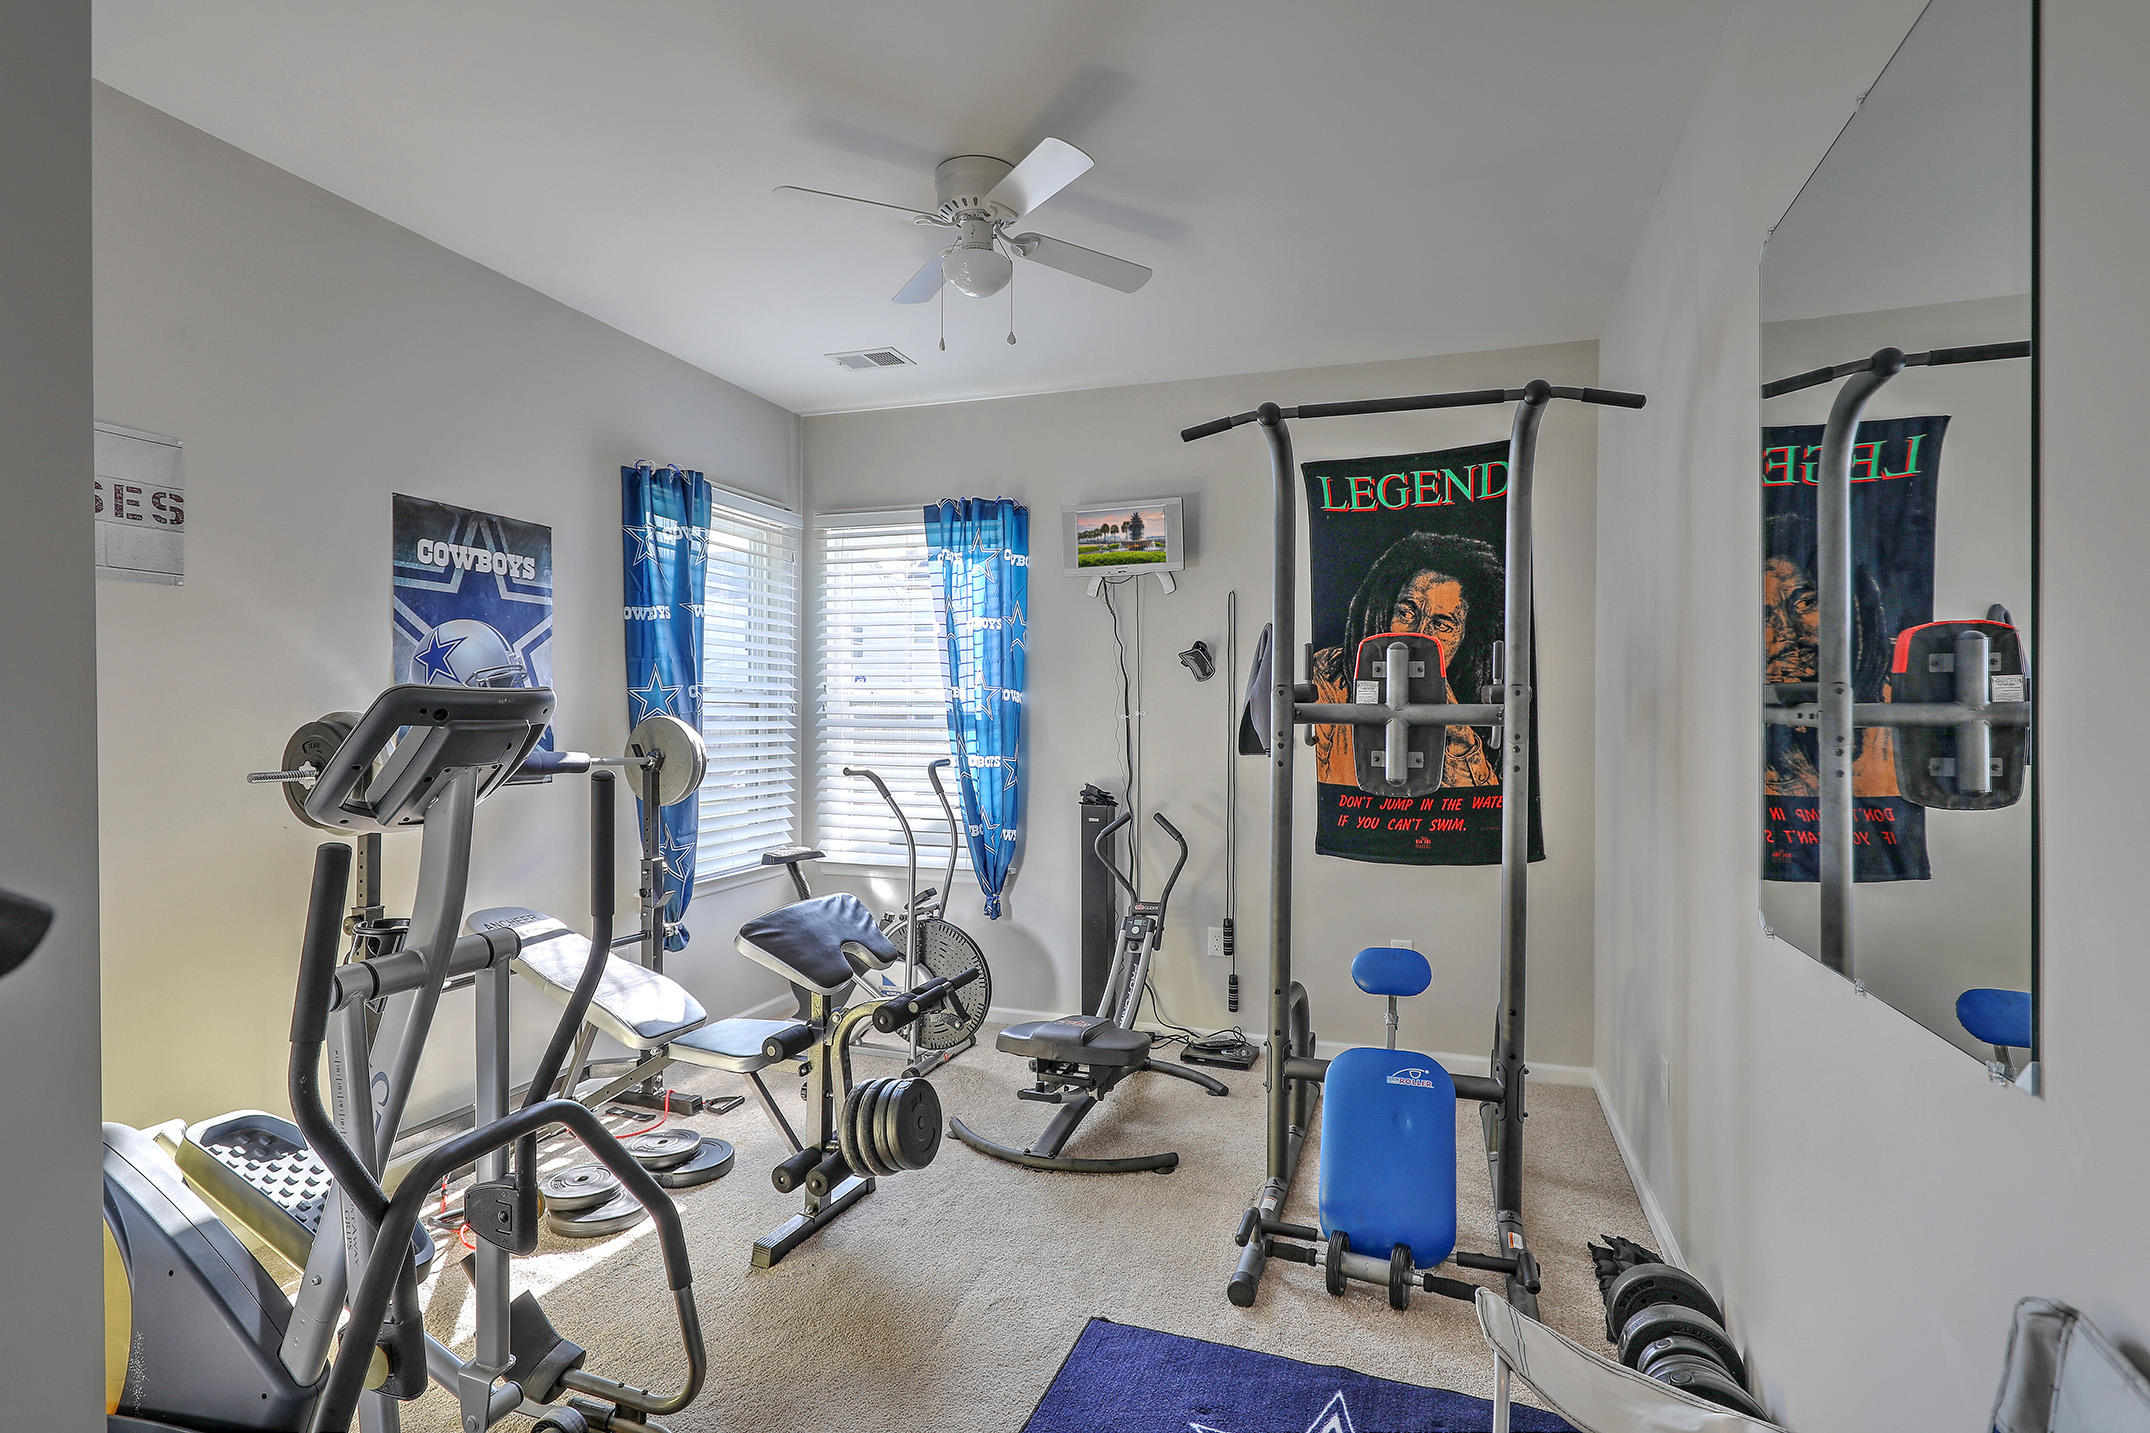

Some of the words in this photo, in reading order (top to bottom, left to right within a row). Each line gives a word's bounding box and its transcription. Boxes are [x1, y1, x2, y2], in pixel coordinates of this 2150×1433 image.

[95, 481, 184, 525] ES
[1316, 460, 1509, 512] LEGEND
[417, 538, 535, 580] COWBOYS
[1337, 814, 1350, 827] IF
[1356, 816, 1380, 830] YOU
[1387, 818, 1422, 831] CAN'T
[1429, 817, 1467, 831] SWIM.
[1339, 794, 1373, 809] DON'T
[1380, 798, 1414, 811] JUMP
[1420, 798, 1434, 811] IN
[1441, 798, 1464, 811] THE
[1472, 795, 1503, 810] WATE
